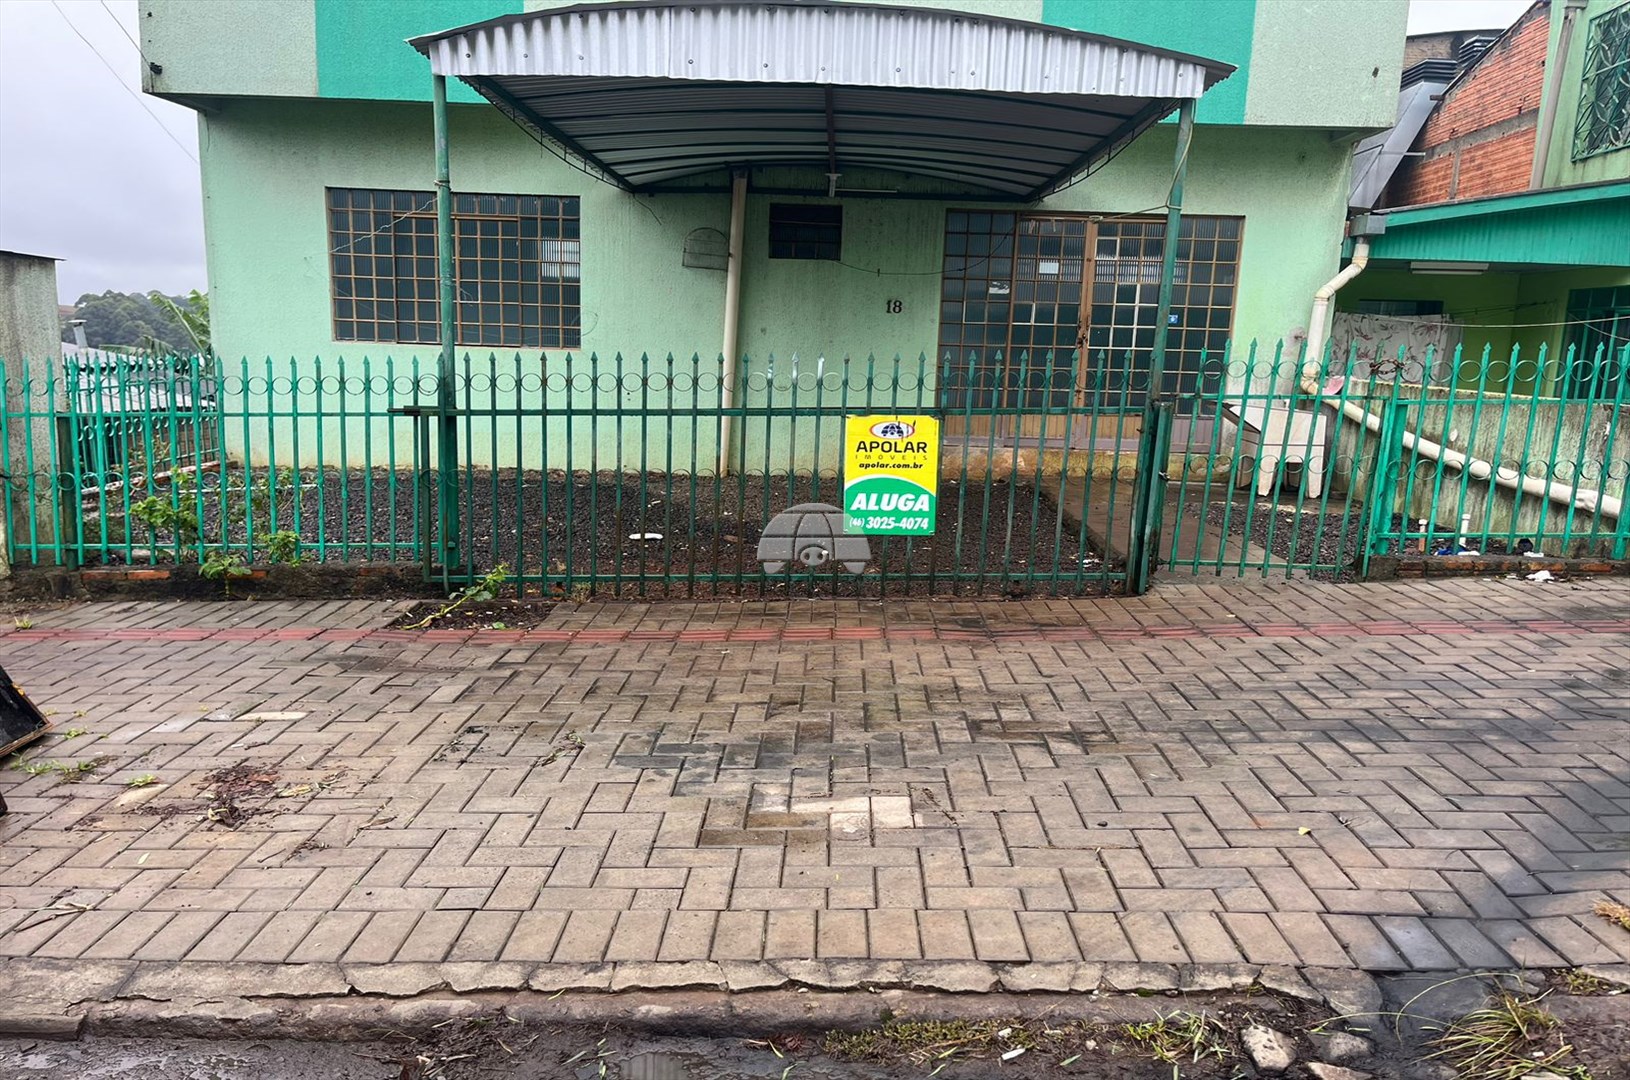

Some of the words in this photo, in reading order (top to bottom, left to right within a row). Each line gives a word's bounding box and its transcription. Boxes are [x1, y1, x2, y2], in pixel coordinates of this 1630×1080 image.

[886, 300, 903, 314] 18
[856, 440, 928, 453] APOLAR
[859, 461, 924, 470] apolar.com.br
[850, 493, 930, 512] ALUGA
[866, 516, 930, 530] 3025-4074
